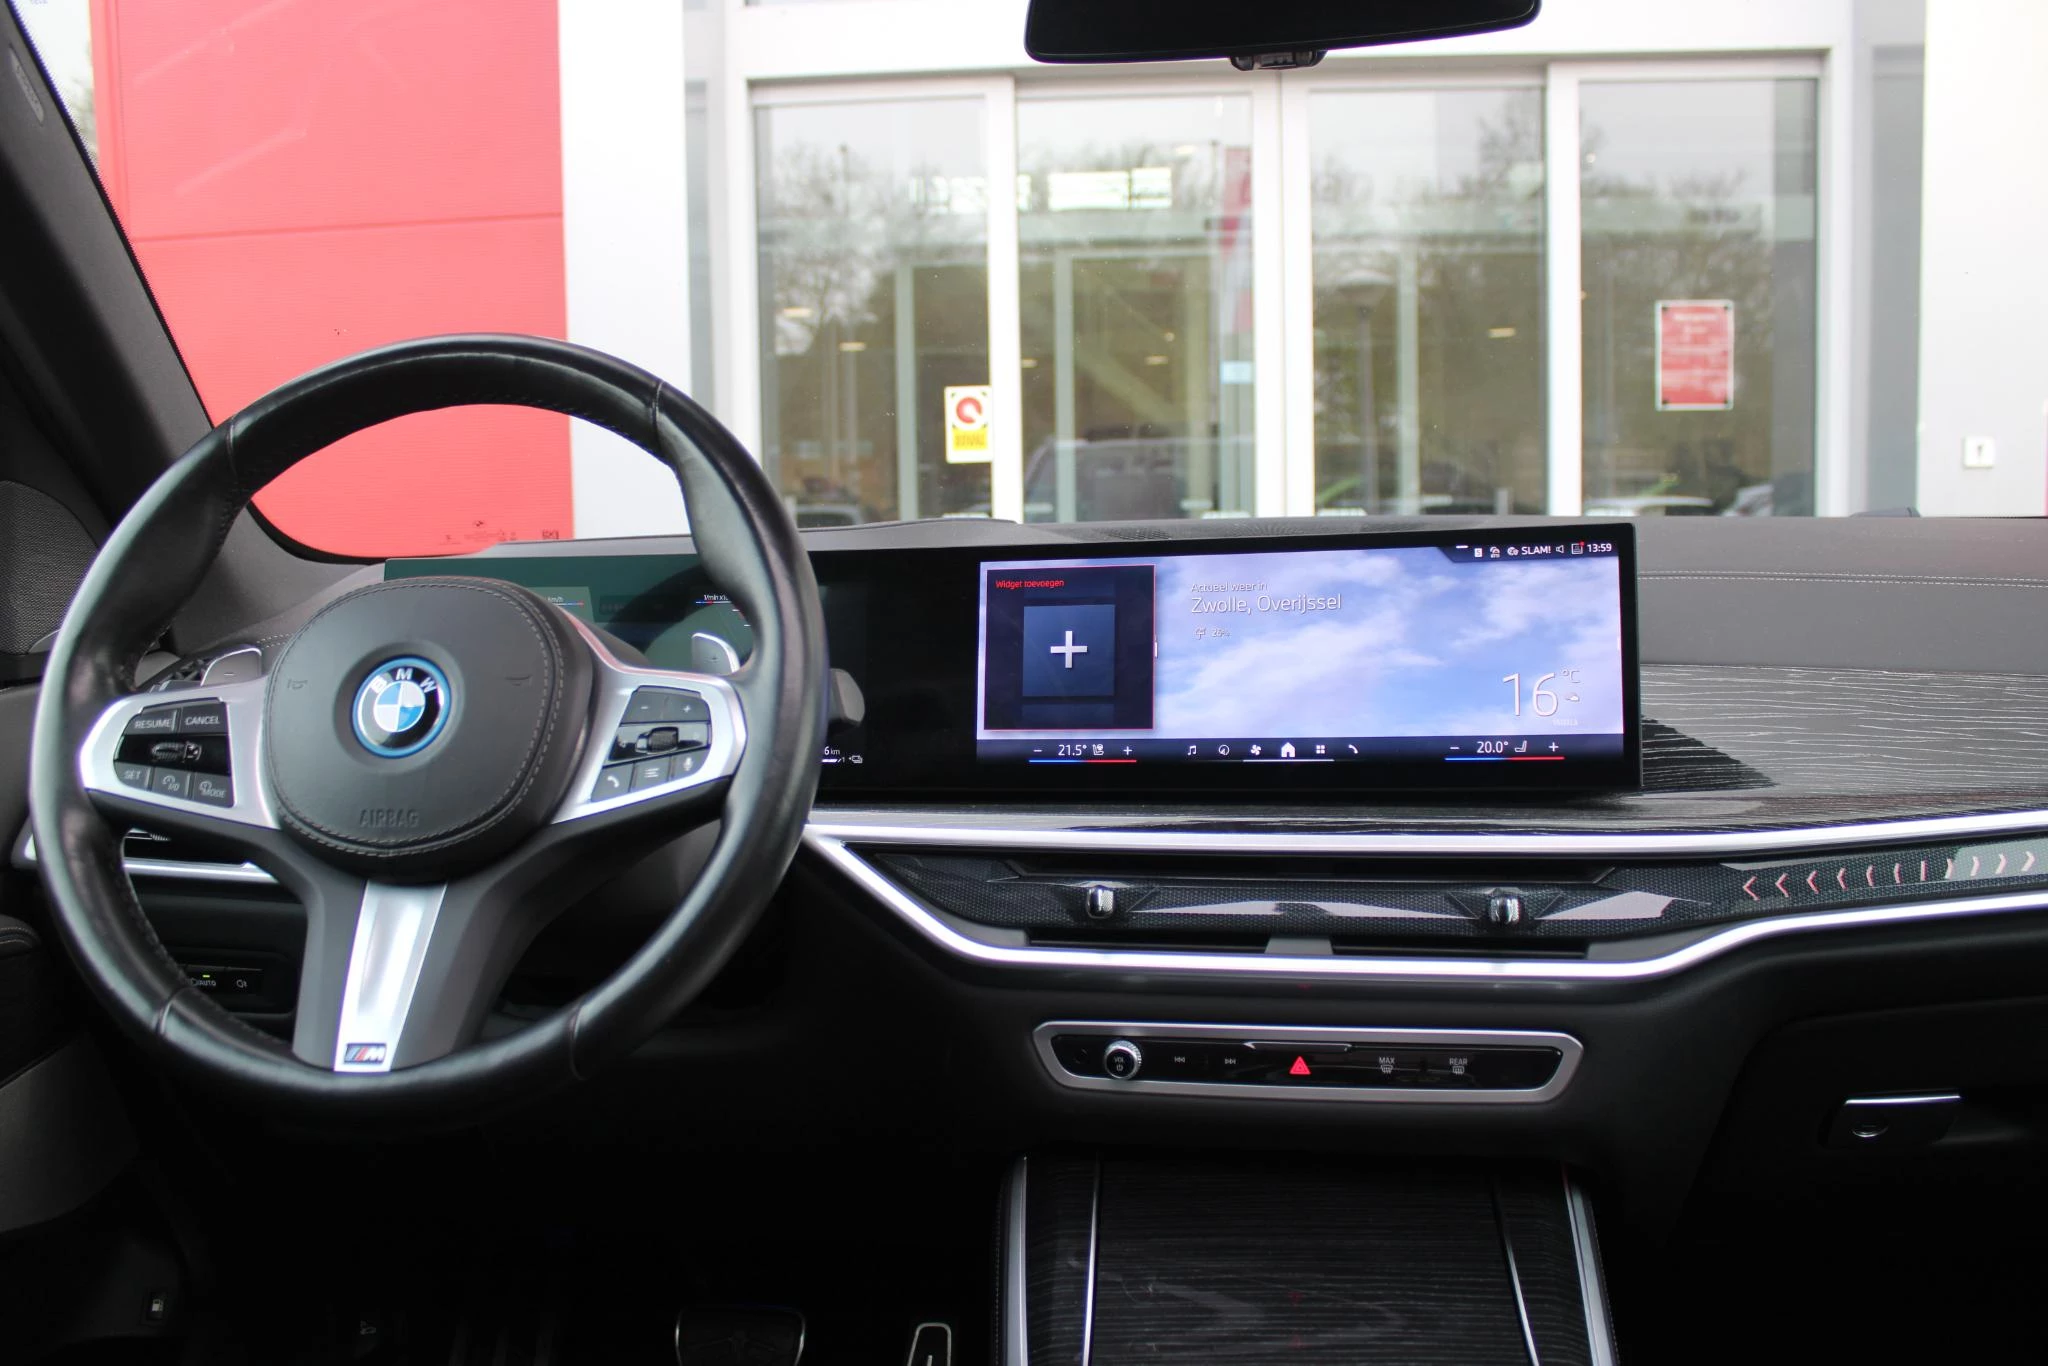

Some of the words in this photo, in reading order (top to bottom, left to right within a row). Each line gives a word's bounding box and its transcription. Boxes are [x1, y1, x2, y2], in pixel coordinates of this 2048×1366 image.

[1521, 546, 1551, 555] SLAM!
[1587, 543, 1612, 553] 13:59
[995, 580, 1022, 590] Widget
[1024, 579, 1065, 589] toevoegen
[1191, 581, 1229, 593] Actueel
[1231, 582, 1256, 592] weer
[1258, 580, 1268, 591] in
[1191, 596, 1252, 615] Zwolle,
[1257, 593, 1342, 614] Overijssel
[370, 667, 437, 694] BMW
[1502, 672, 1559, 717] 16
[134, 719, 171, 730] RESUME
[184, 716, 220, 726] CANCEL
[1058, 744, 1087, 756] 21.5°
[1476, 740, 1509, 754] 20.0°
[123, 770, 141, 780] SET
[203, 788, 226, 799] MODE
[359, 808, 419, 828] AIRBAG
[1378, 1057, 1396, 1065] MAX
[1449, 1058, 1468, 1066] REAR
